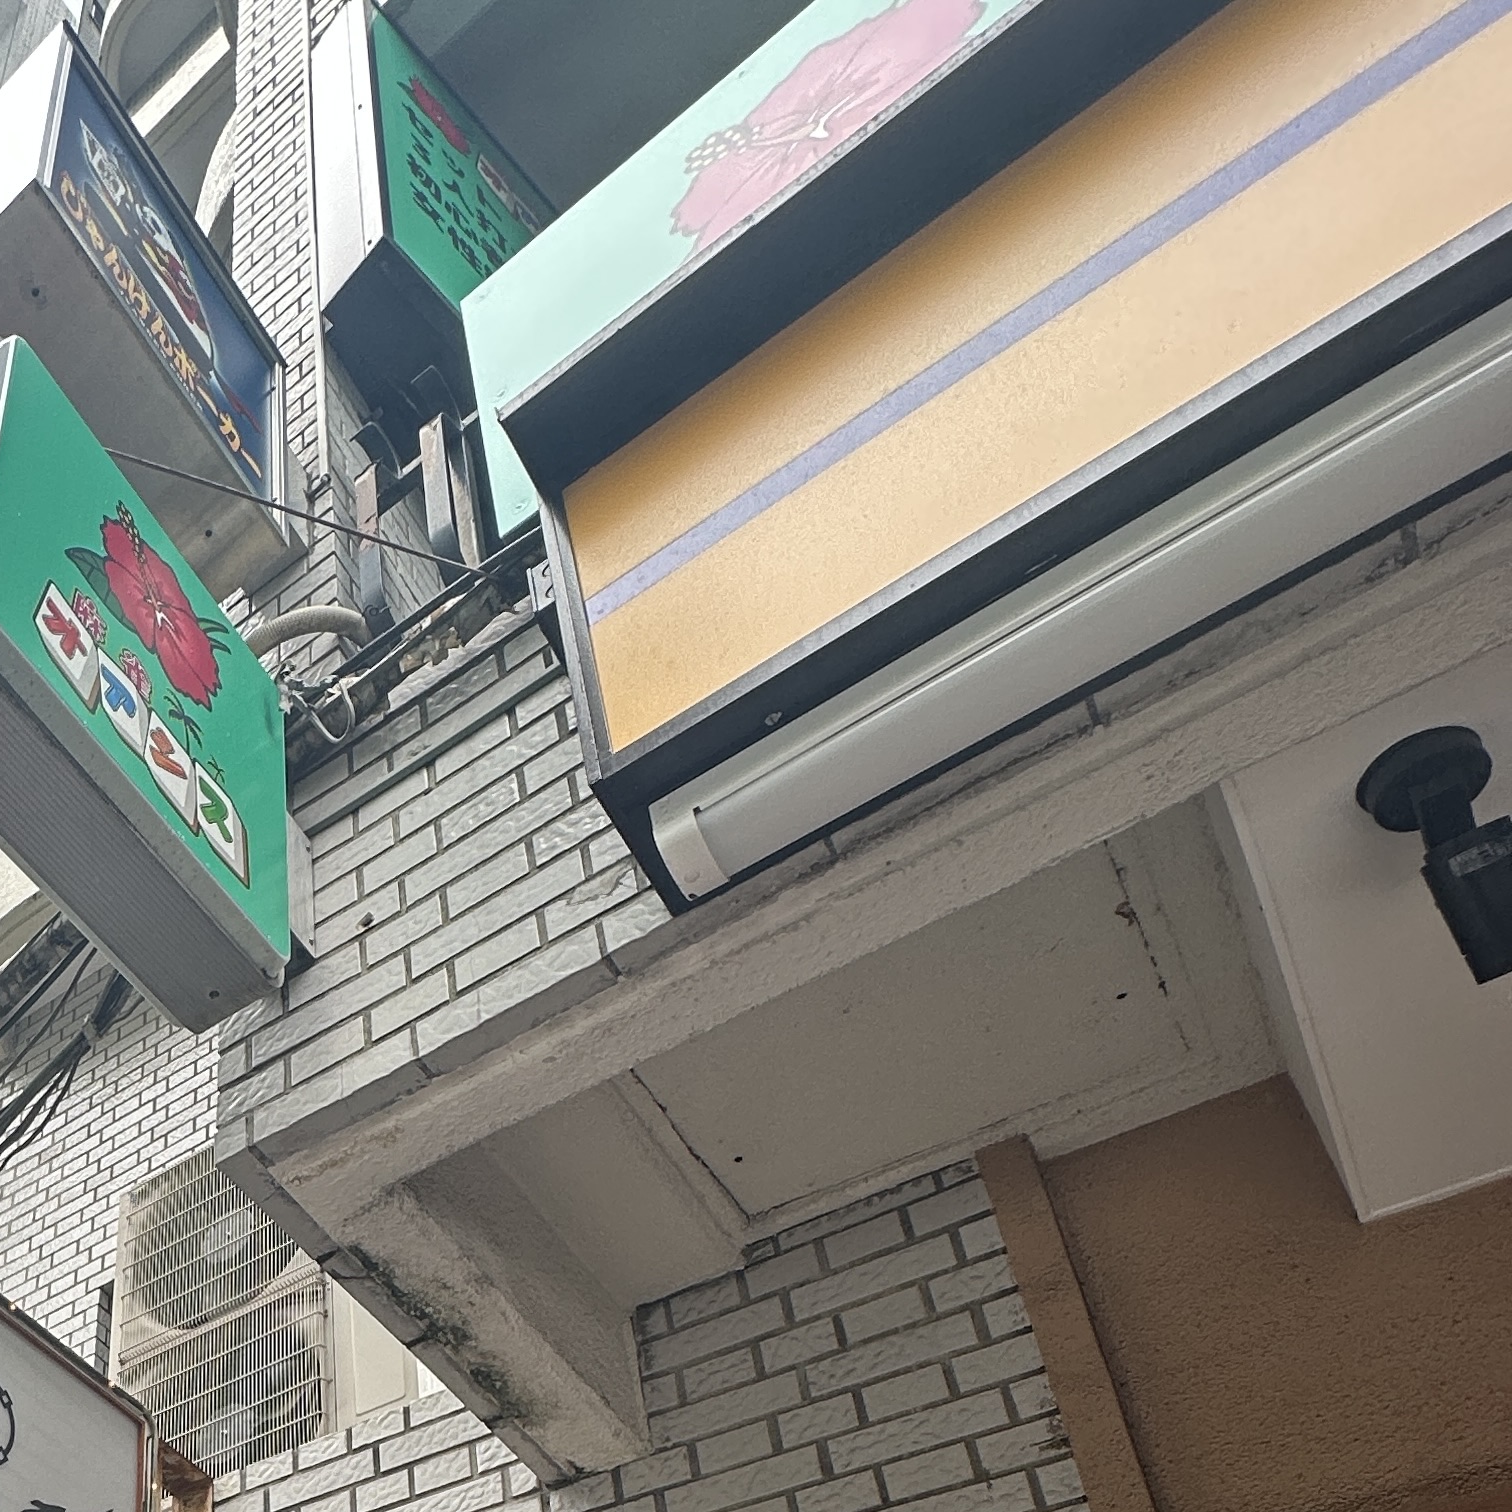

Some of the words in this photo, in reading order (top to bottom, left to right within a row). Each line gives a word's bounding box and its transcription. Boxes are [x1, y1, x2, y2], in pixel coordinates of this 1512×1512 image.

[409, 182, 493, 279] 女性
[40, 594, 234, 844] オアシス
